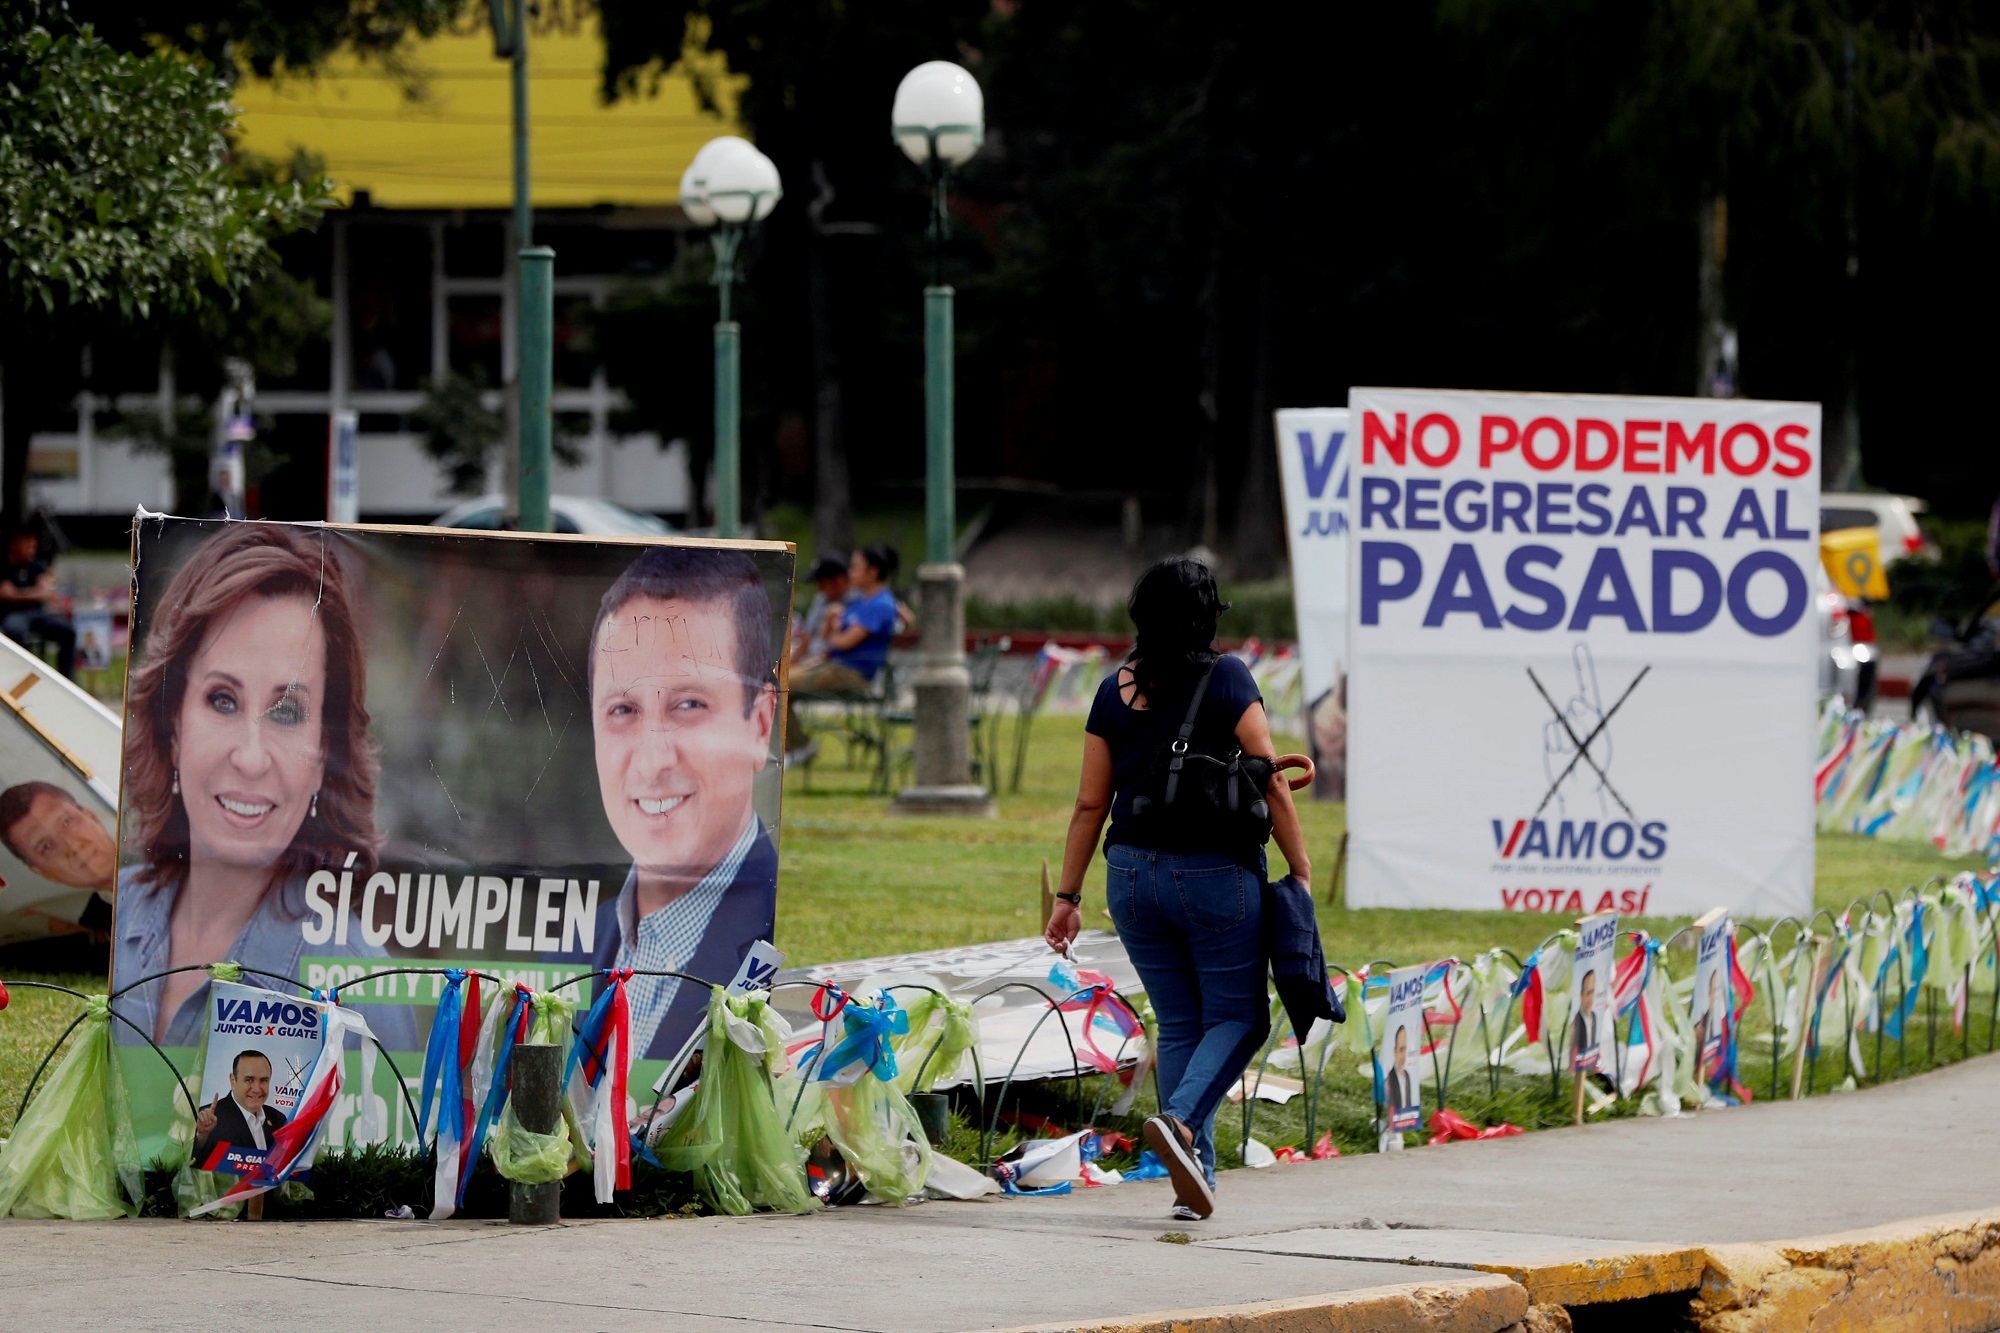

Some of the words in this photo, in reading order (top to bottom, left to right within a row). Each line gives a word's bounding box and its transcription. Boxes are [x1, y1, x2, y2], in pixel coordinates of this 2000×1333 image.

[1361, 411, 1461, 468] NO
[1479, 414, 1813, 479] PODEMOS
[1360, 476, 1708, 539] REGRESAR
[1722, 487, 1811, 541] AL
[1359, 541, 1810, 638] PASADO
[1491, 819, 1668, 861] VAMOS
[302, 852, 358, 946] SÍ
[360, 871, 600, 954] CUMPLEN
[1501, 888, 1584, 914] VOTA
[1594, 882, 1652, 916] ASÍ
[308, 964, 365, 997] POR
[371, 965, 397, 998] TI
[404, 967, 425, 998] Y
[216, 998, 318, 1028] VAMOS
[214, 1022, 262, 1036] JUNTOS
[264, 1026, 275, 1036] X
[277, 1027, 319, 1040] GUATE
[274, 1099, 295, 1108] VOTA
[227, 1152, 243, 1162] DR.
